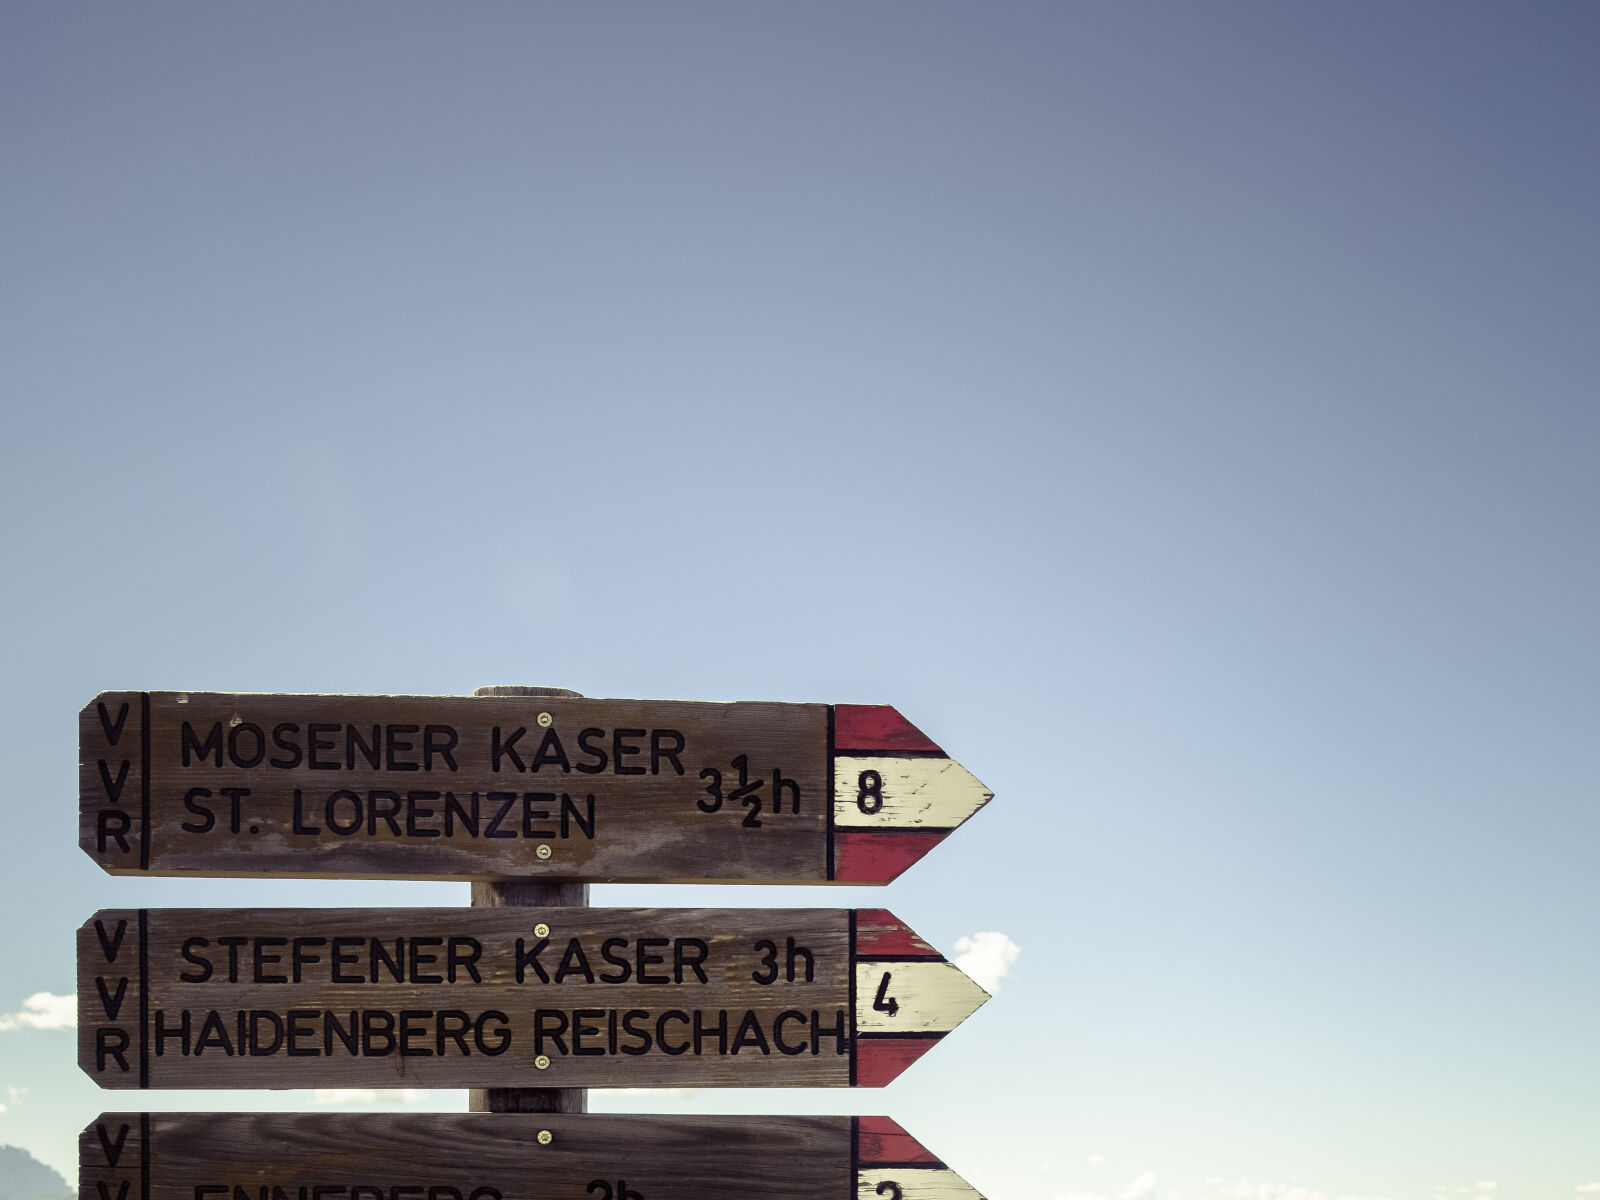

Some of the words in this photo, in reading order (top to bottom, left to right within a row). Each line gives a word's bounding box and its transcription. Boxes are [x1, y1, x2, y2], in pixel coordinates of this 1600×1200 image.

[182, 721, 459, 771] MOSENER
[492, 726, 686, 775] KASER
[182, 787, 260, 834] ST.
[293, 788, 596, 839] LORENZEN
[857, 769, 883, 815] 8
[180, 937, 483, 985] STEFENER
[515, 938, 709, 985] KASER
[752, 937, 814, 985] 3h
[873, 972, 899, 1017] 4
[155, 1010, 512, 1057] HAIDENBERG
[534, 1009, 845, 1056] REISCHACH
